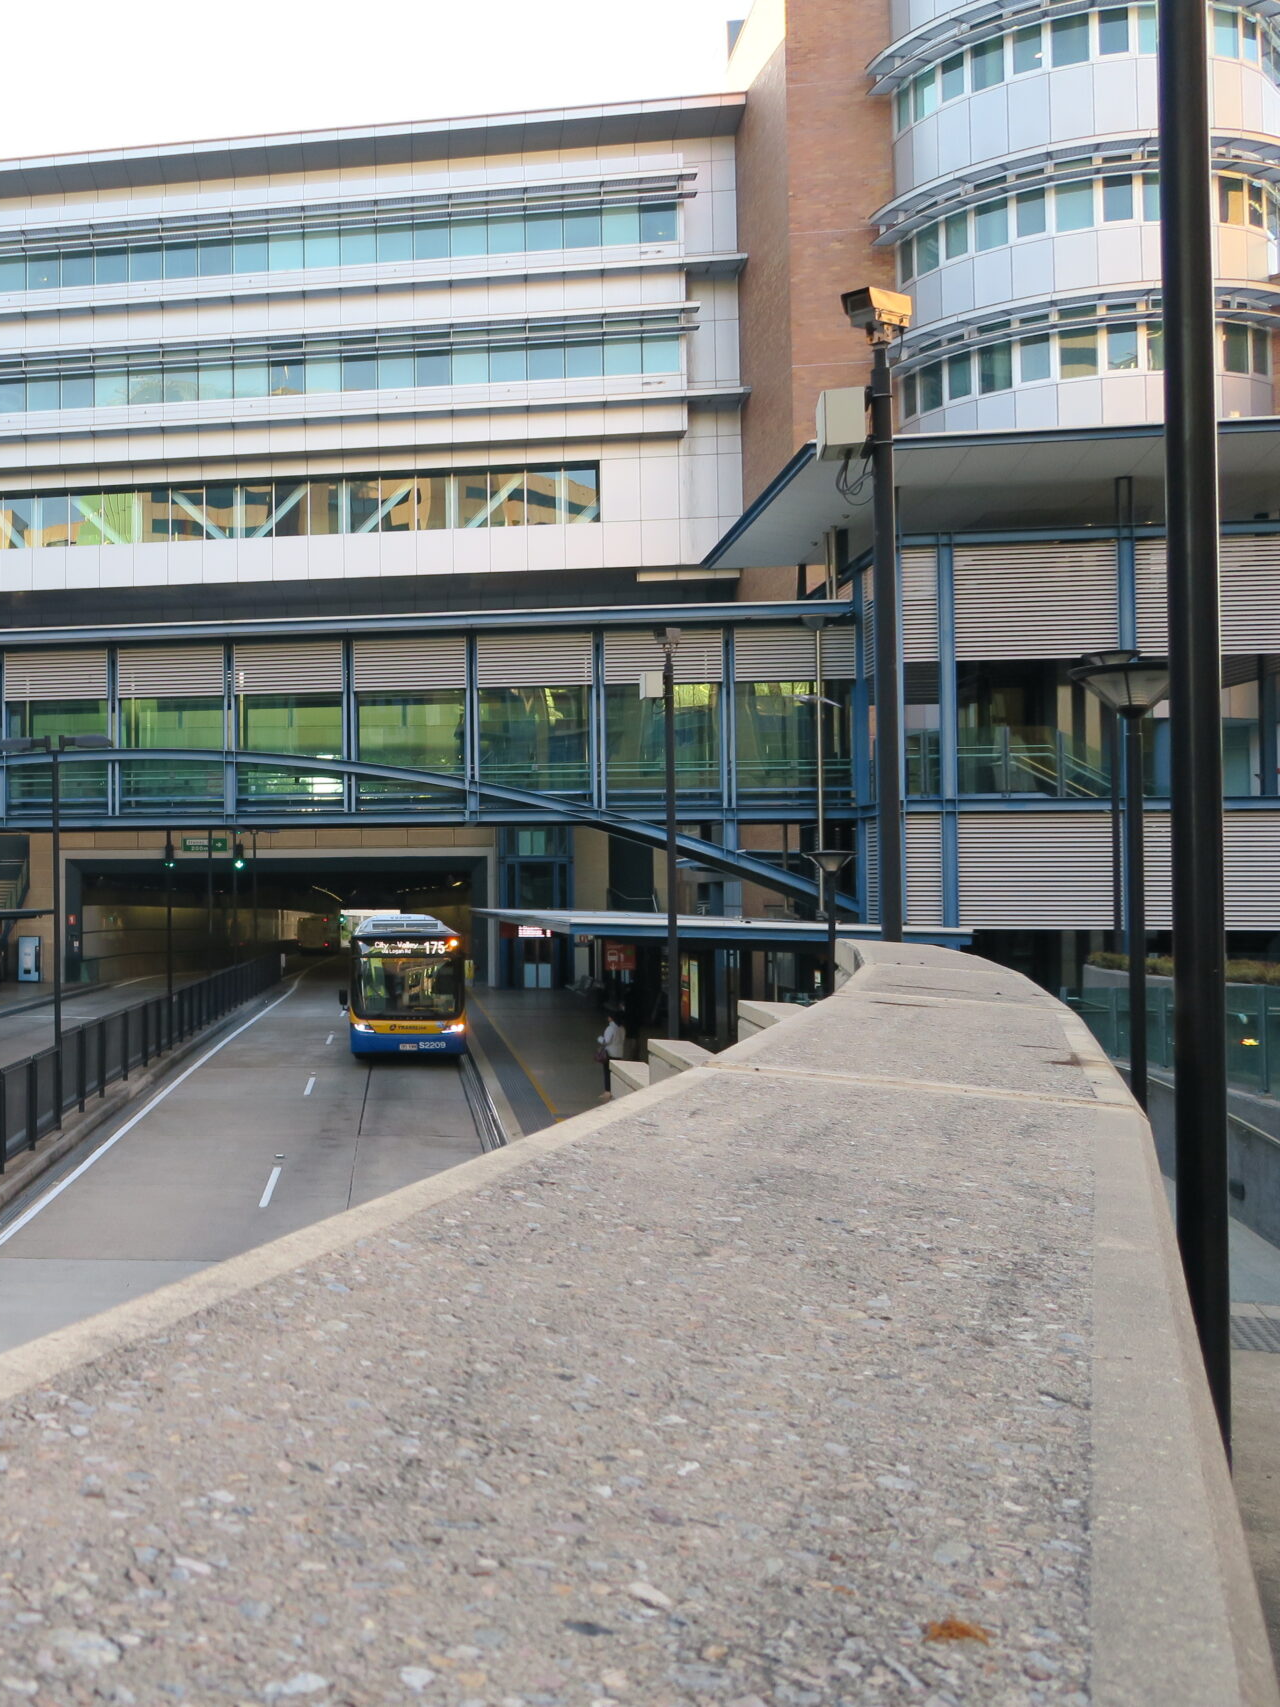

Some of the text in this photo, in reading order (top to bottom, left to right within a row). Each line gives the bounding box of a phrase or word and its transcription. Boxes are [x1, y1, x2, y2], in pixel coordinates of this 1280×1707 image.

[374, 941, 389, 949] City
[397, 941, 418, 949] Valley
[423, 941, 446, 954] 175
[419, 1041, 446, 1049] S2209
